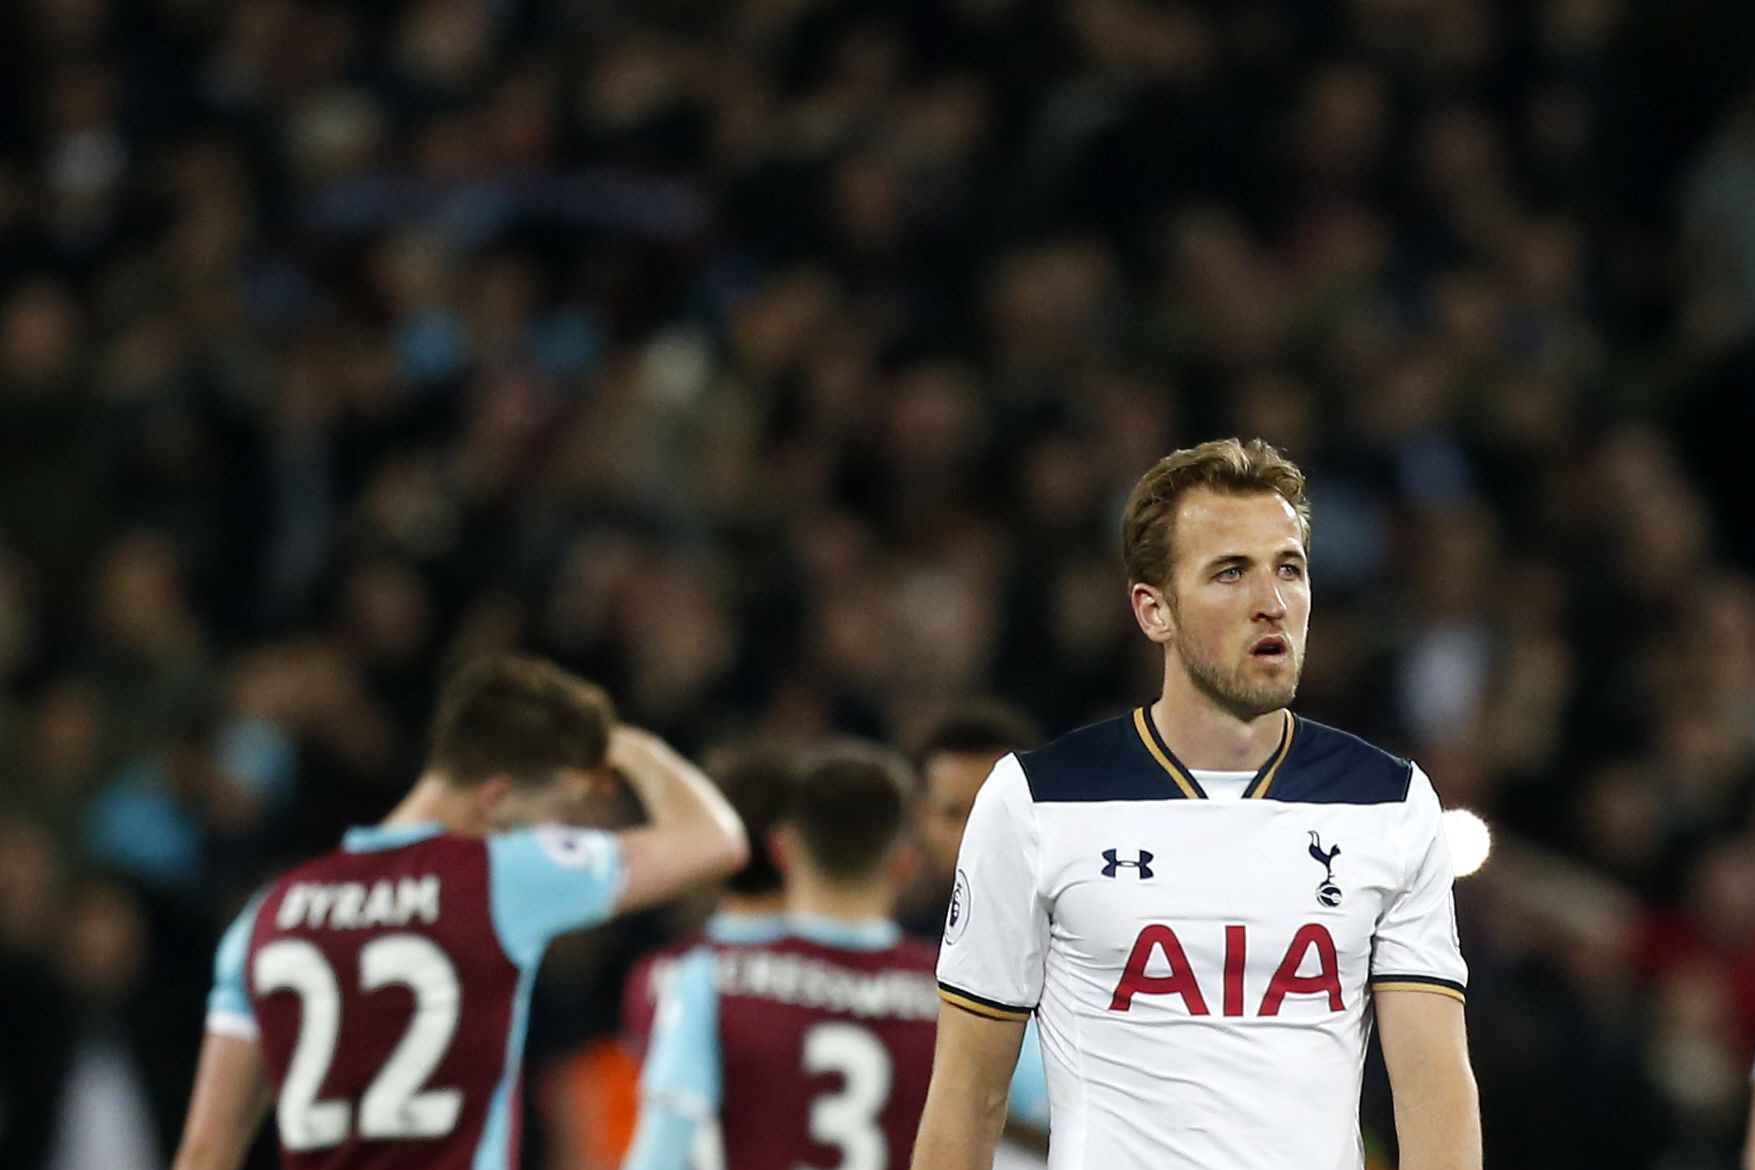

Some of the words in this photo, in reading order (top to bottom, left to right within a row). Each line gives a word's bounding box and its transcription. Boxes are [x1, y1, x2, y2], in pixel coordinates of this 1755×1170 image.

[276, 873, 441, 931] BYRAM
[1108, 922, 1346, 1018] AIA
[252, 934, 464, 1152] 22
